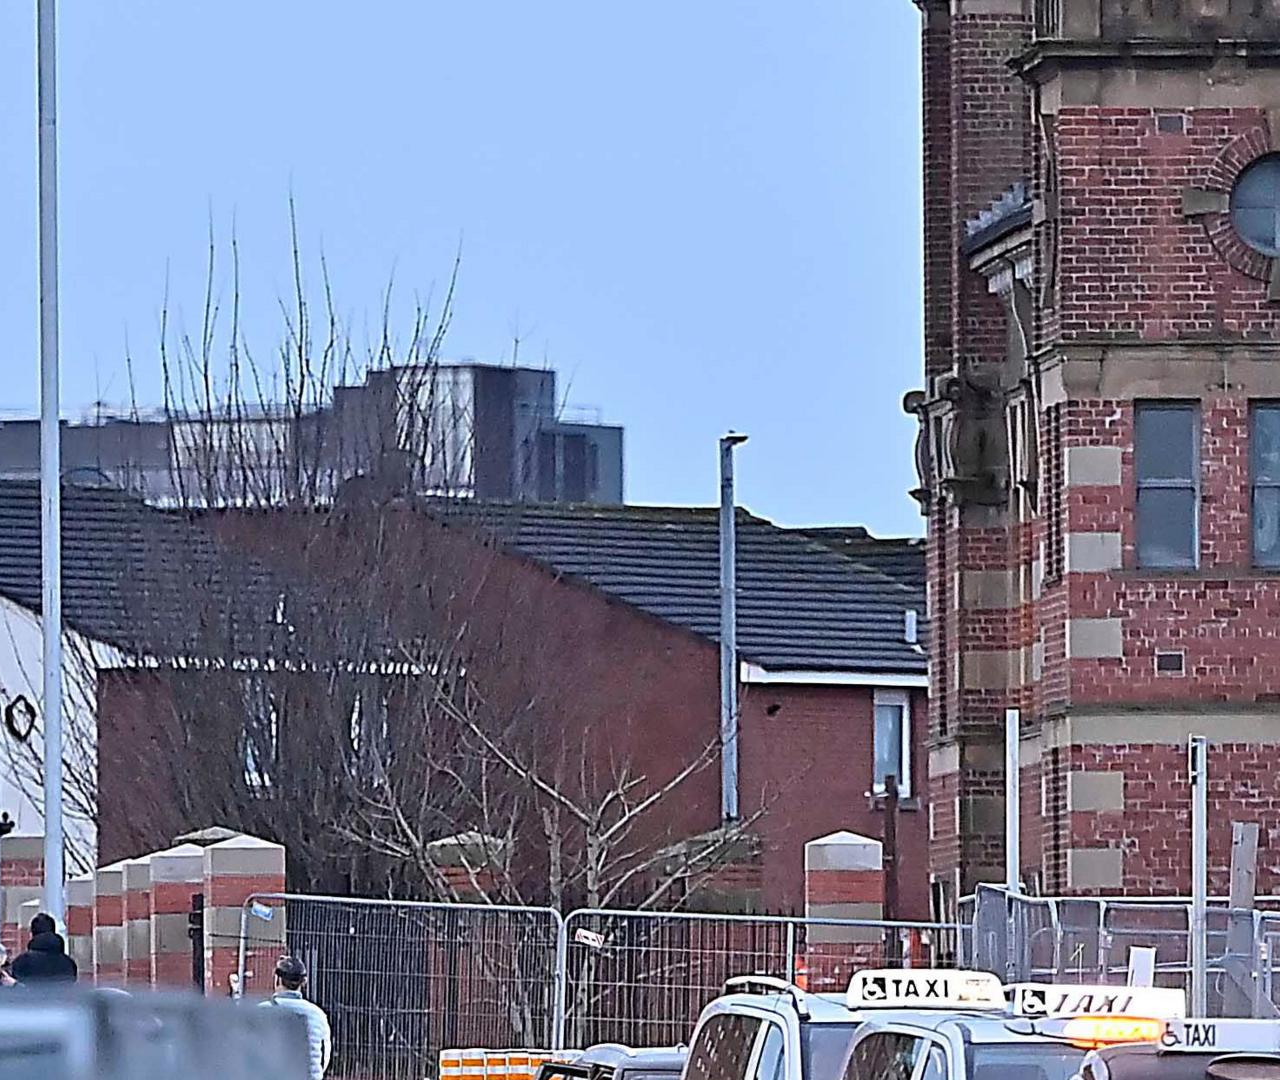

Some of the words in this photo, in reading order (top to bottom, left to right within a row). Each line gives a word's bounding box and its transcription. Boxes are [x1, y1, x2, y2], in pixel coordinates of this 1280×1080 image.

[892, 979, 949, 998] TAXI
[1053, 994, 1133, 1013] TAXI
[1183, 1024, 1216, 1047] TAXI
